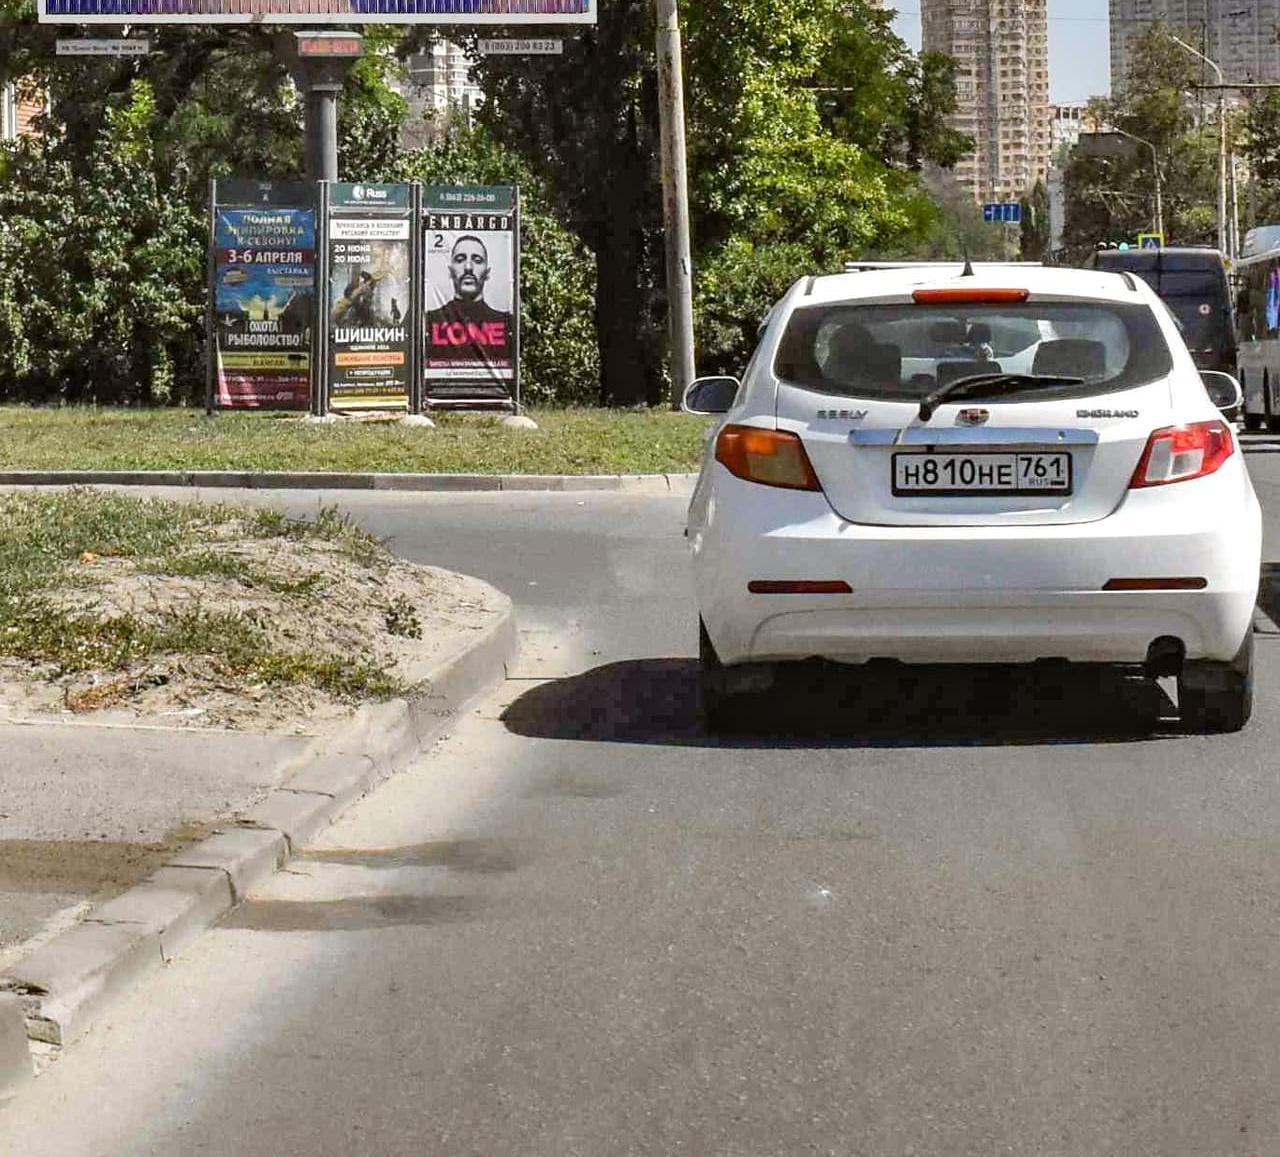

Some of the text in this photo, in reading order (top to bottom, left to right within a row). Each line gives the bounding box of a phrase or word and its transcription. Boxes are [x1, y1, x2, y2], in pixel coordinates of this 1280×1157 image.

[429, 215, 508, 229] EMBARGO
[434, 234, 444, 248] 2
[228, 249, 303, 263] 3-6 АПРЕЛЯ
[228, 333, 300, 346] РЫБОЛОВСТВО
[334, 326, 405, 343] ШИШКИН
[1019, 456, 1062, 478] 761
